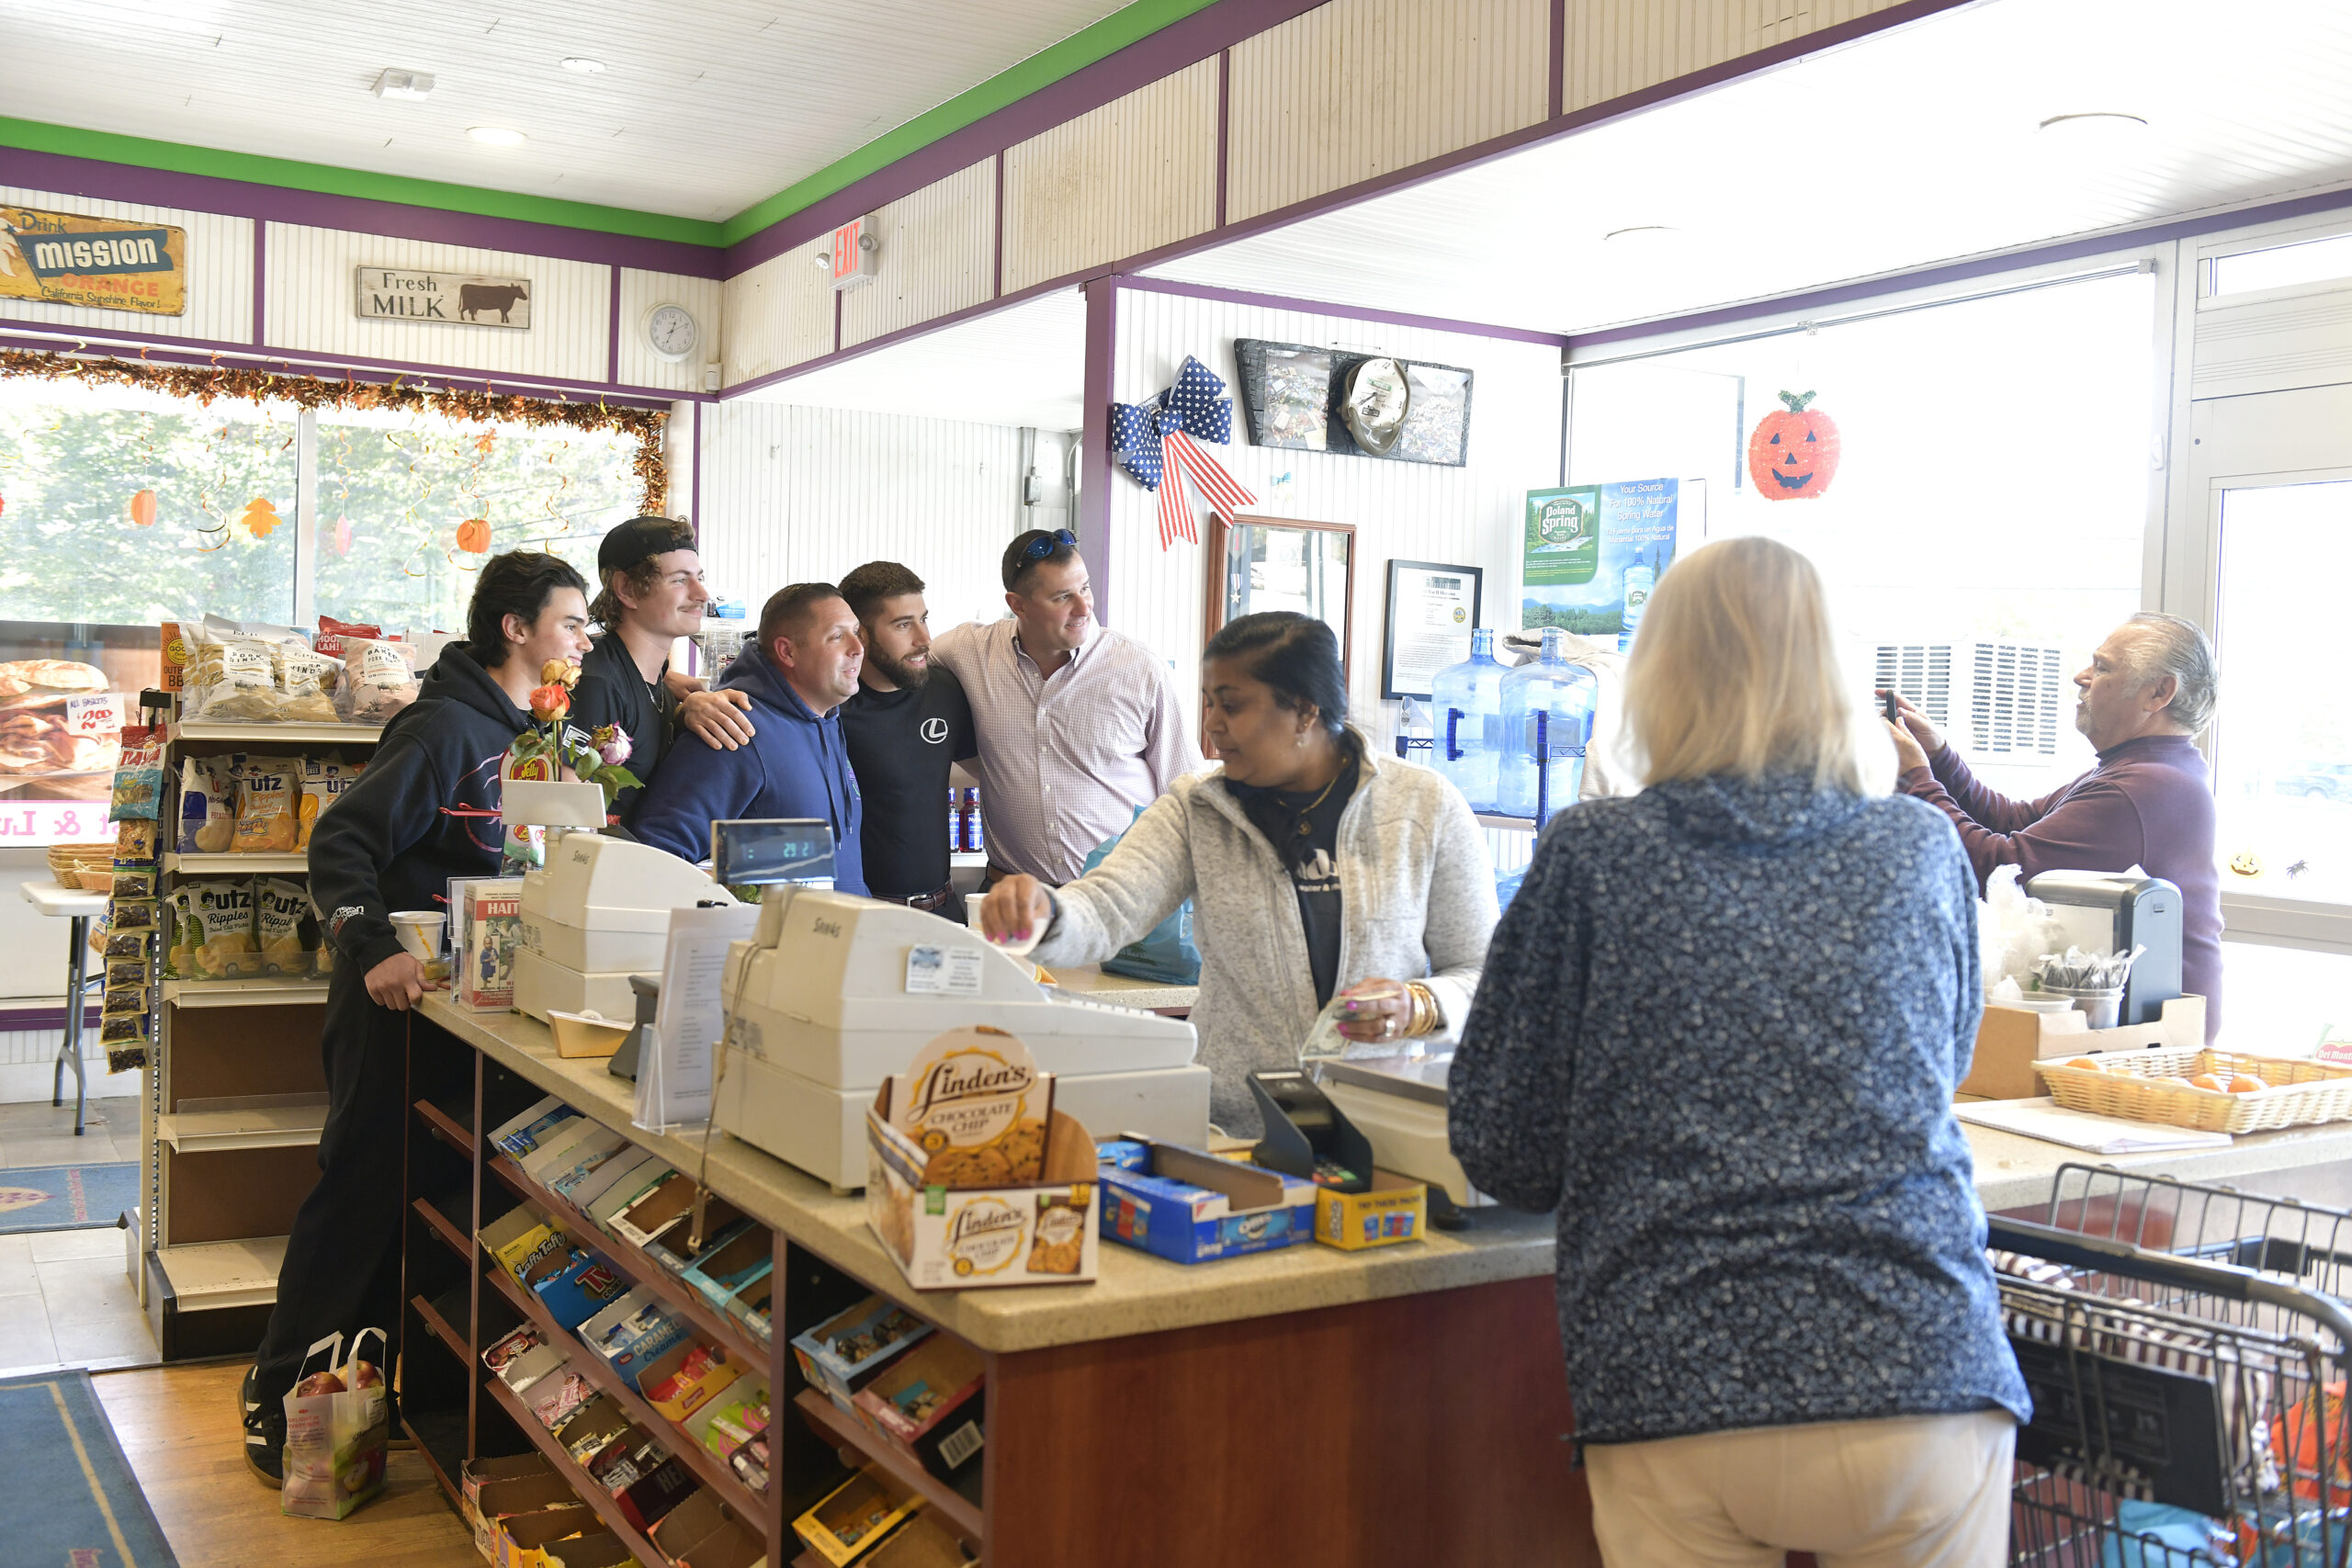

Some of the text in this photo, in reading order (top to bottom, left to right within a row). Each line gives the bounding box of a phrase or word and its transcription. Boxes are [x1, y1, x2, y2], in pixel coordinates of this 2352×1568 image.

[18, 213, 66, 234] Drink
[835, 220, 861, 278] EXIT
[61, 273, 159, 297] ORANGE
[382, 272, 437, 291] Fresh
[41, 286, 84, 302] California
[86, 292, 127, 306] Sunshine
[373, 294, 446, 318] MILK
[1620, 483, 1664, 494] Your Source
[1623, 497, 1645, 507] 100%
[1646, 493, 1674, 504] Natural
[1546, 505, 1576, 518] Poland
[1617, 508, 1664, 522] Spring Water
[1542, 514, 1578, 535] Spring
[521, 757, 539, 781] Jelly
[207, 910, 249, 927] Ripples
[920, 1061, 1032, 1117] Linden's
[930, 1102, 1012, 1125] CHOCOLATE
[952, 1118, 989, 1134] CHIP
[537, 1231, 567, 1256] Taffy
[633, 1317, 683, 1357] CARAMEL
